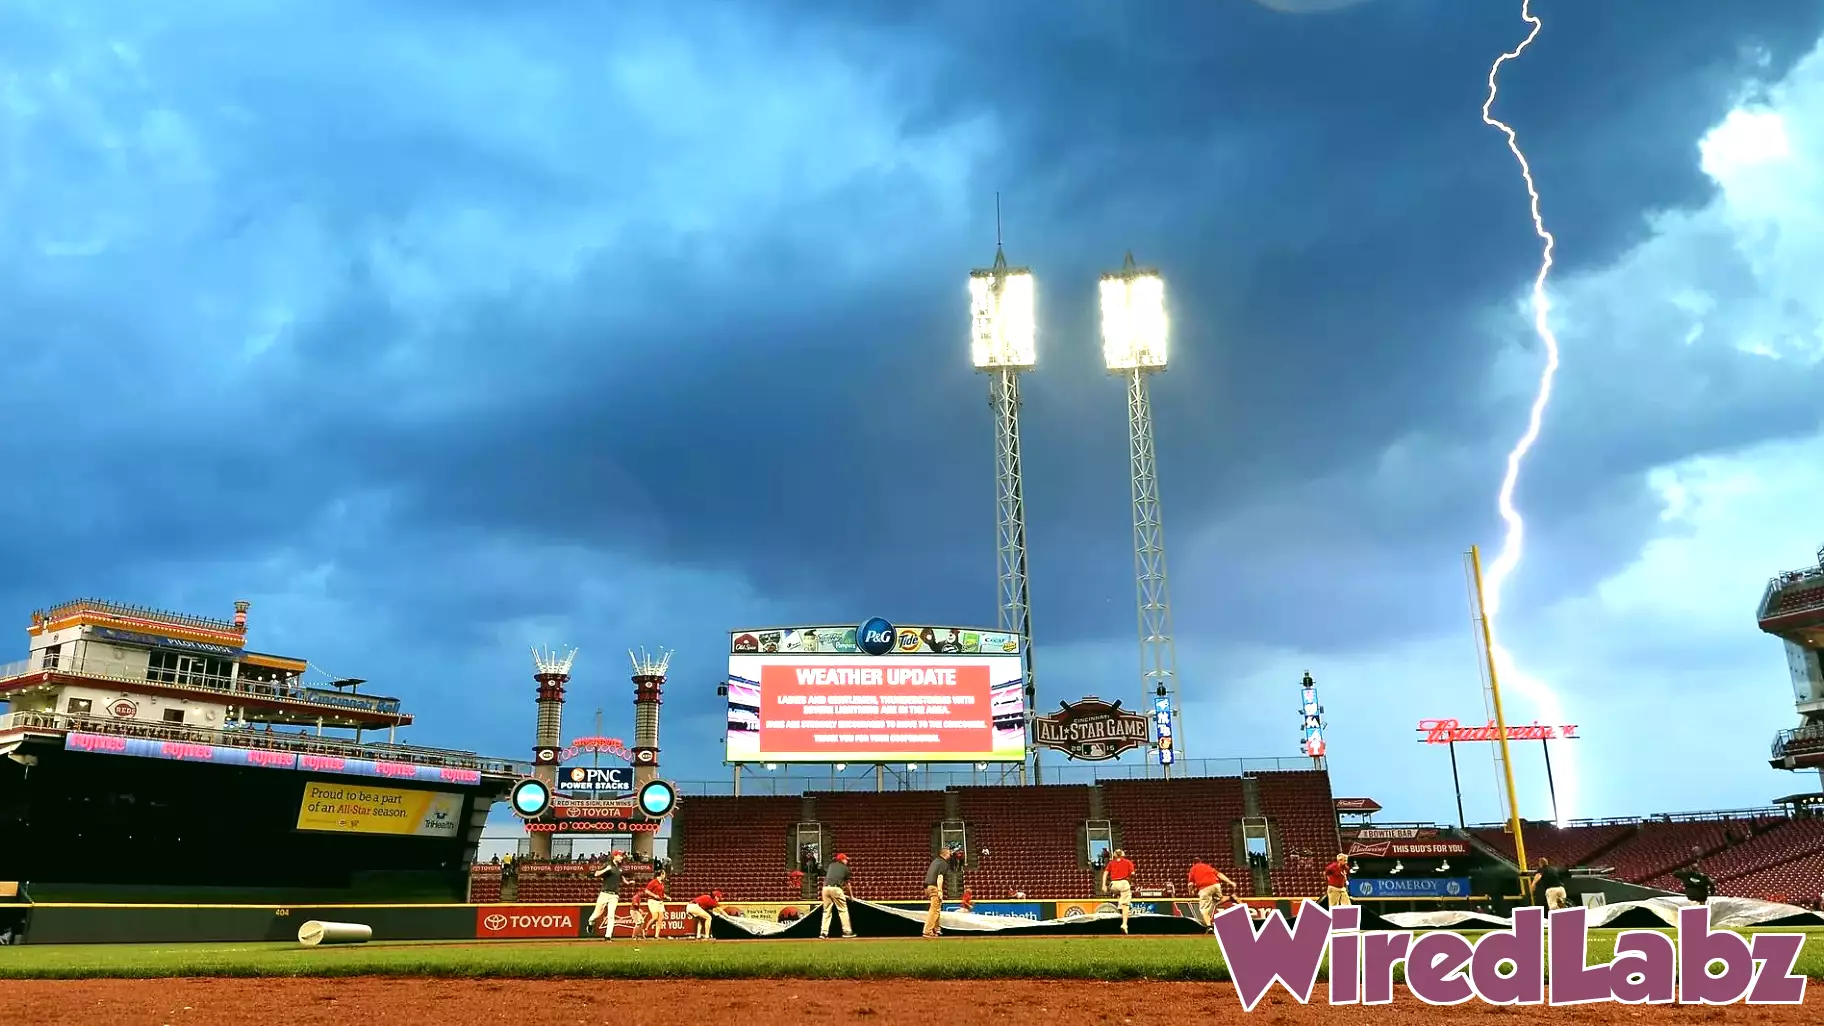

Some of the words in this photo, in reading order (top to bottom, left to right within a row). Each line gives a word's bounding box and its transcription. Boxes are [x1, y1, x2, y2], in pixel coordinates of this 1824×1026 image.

[865, 630, 892, 643] P&G
[898, 635, 919, 648] Tide
[167, 638, 196, 649] PILOT
[197, 641, 233, 653] HOUSE
[796, 668, 883, 685] WEATHER
[886, 668, 957, 685] UPDATE
[115, 706, 136, 714] REDS
[1073, 714, 1110, 723] CINCINNATI
[1106, 718, 1145, 737] GAME
[70, 733, 126, 751] FUJITEC
[162, 742, 213, 760] FUJITEC
[247, 749, 293, 766] FUJITEC
[301, 754, 345, 772] FUJITEC
[375, 760, 416, 777] FUJITEC
[440, 766, 478, 782] FUJITEC
[586, 769, 621, 782] PNC
[310, 787, 344, 800] Proud
[346, 790, 357, 800] to
[359, 791, 372, 802] be
[373, 795, 379, 803] a
[381, 794, 402, 806] part
[308, 801, 321, 812] of
[321, 805, 335, 813] an
[337, 804, 371, 815] All-Star
[582, 808, 621, 817] TOYOTA
[424, 819, 454, 830] TriHealth
[1392, 845, 1409, 853] THIS
[1410, 845, 1432, 853] BUD'S
[1433, 845, 1447, 853] FOR
[1448, 844, 1466, 853] YOU.
[1378, 880, 1437, 890] POMEROY
[510, 915, 572, 928] TOYOTA
[651, 921, 667, 930] FR
[668, 921, 686, 930] YOU.
